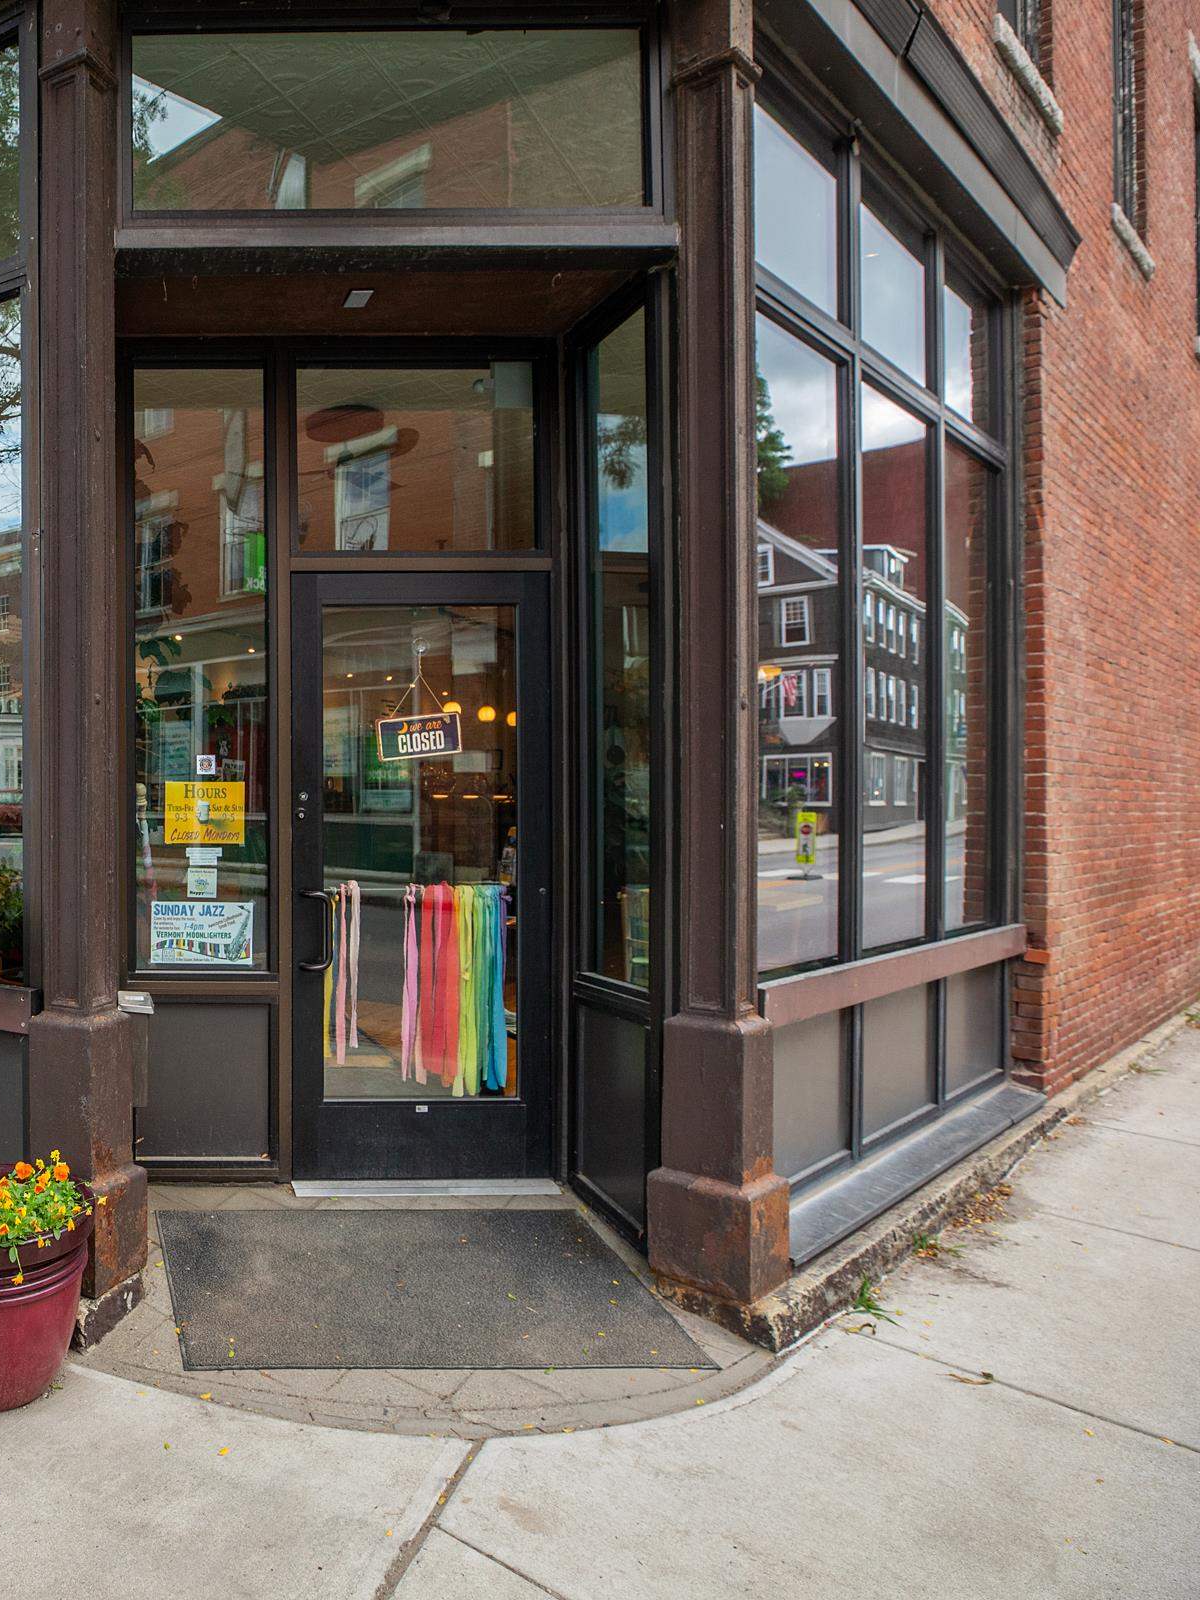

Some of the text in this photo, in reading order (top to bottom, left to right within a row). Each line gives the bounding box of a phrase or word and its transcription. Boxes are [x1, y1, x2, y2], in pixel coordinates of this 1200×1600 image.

[409, 720, 442, 732] we are
[397, 730, 445, 754] CLOSED
[153, 903, 225, 917] SUNDAY JAZZ
[184, 923, 204, 931] 1-4pm
[156, 931, 231, 939] VERMONT MOONLIGHTERS
